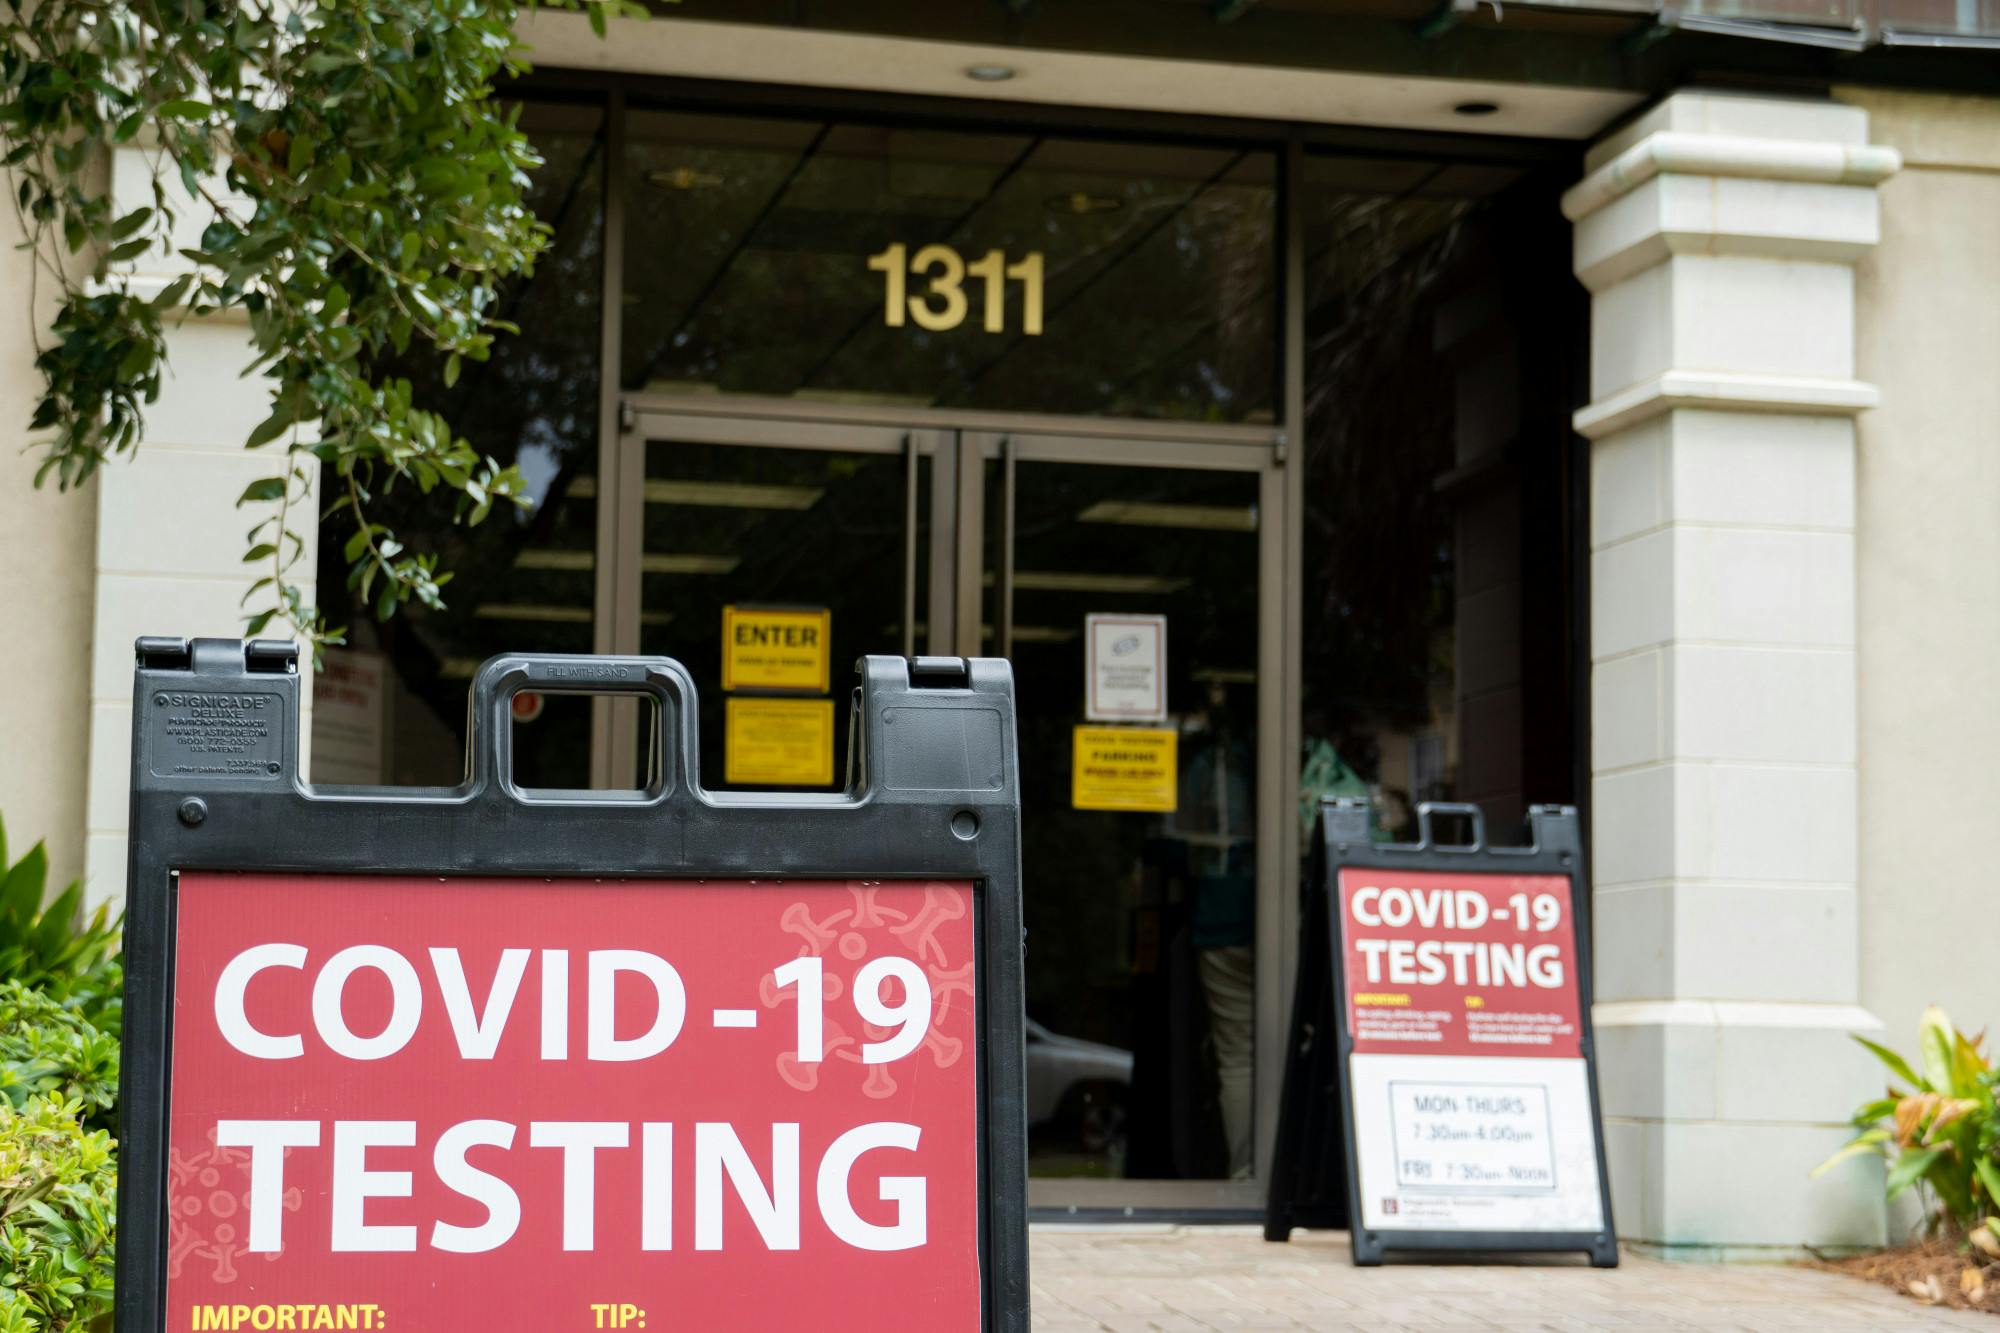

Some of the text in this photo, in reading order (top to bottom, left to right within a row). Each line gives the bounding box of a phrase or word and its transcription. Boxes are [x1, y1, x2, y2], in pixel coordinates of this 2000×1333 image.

[867, 243, 1044, 336] 1311
[735, 623, 818, 648] ENTER
[547, 665, 629, 679] FILL WITH SAND
[192, 708, 245, 718] DELUXE
[1355, 938, 1564, 988] TESTING
[216, 1119, 927, 1253] TESTING
[191, 1304, 386, 1331] IMPORTANT:
[590, 1303, 647, 1330] TIP:
